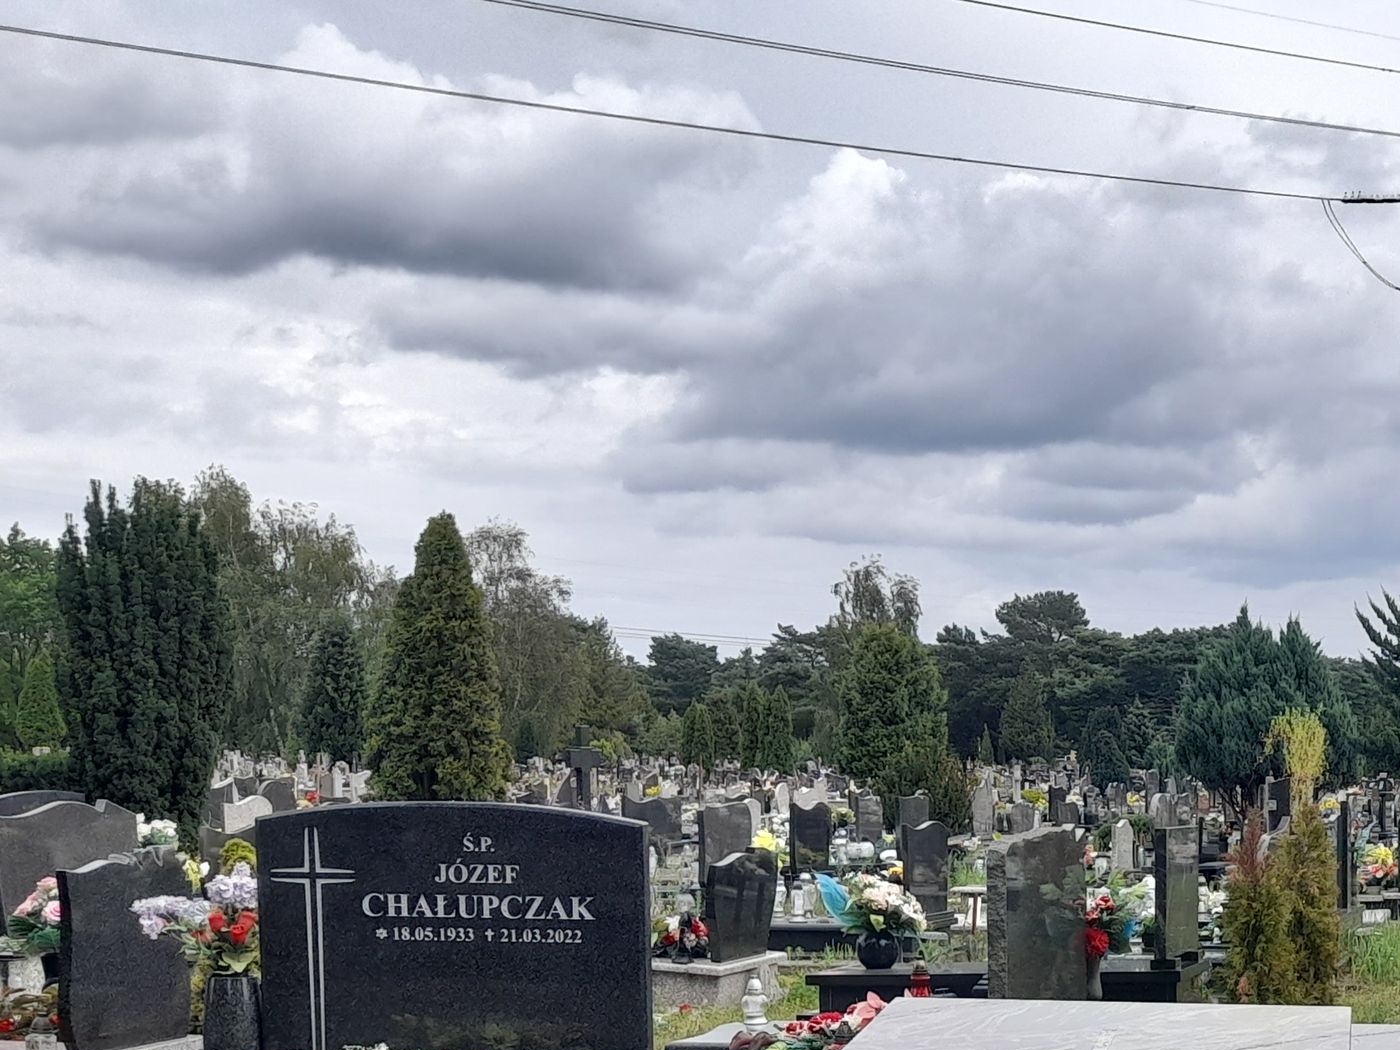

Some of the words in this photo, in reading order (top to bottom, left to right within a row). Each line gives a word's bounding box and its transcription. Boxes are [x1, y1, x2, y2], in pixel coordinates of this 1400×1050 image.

[462, 832, 495, 852] Ś.P.
[434, 858, 520, 884] JÓZEF
[361, 892, 596, 920] CHAŁUPCZAK
[392, 926, 475, 942] 18.05.1933
[499, 928, 582, 943] 21.03.2022
